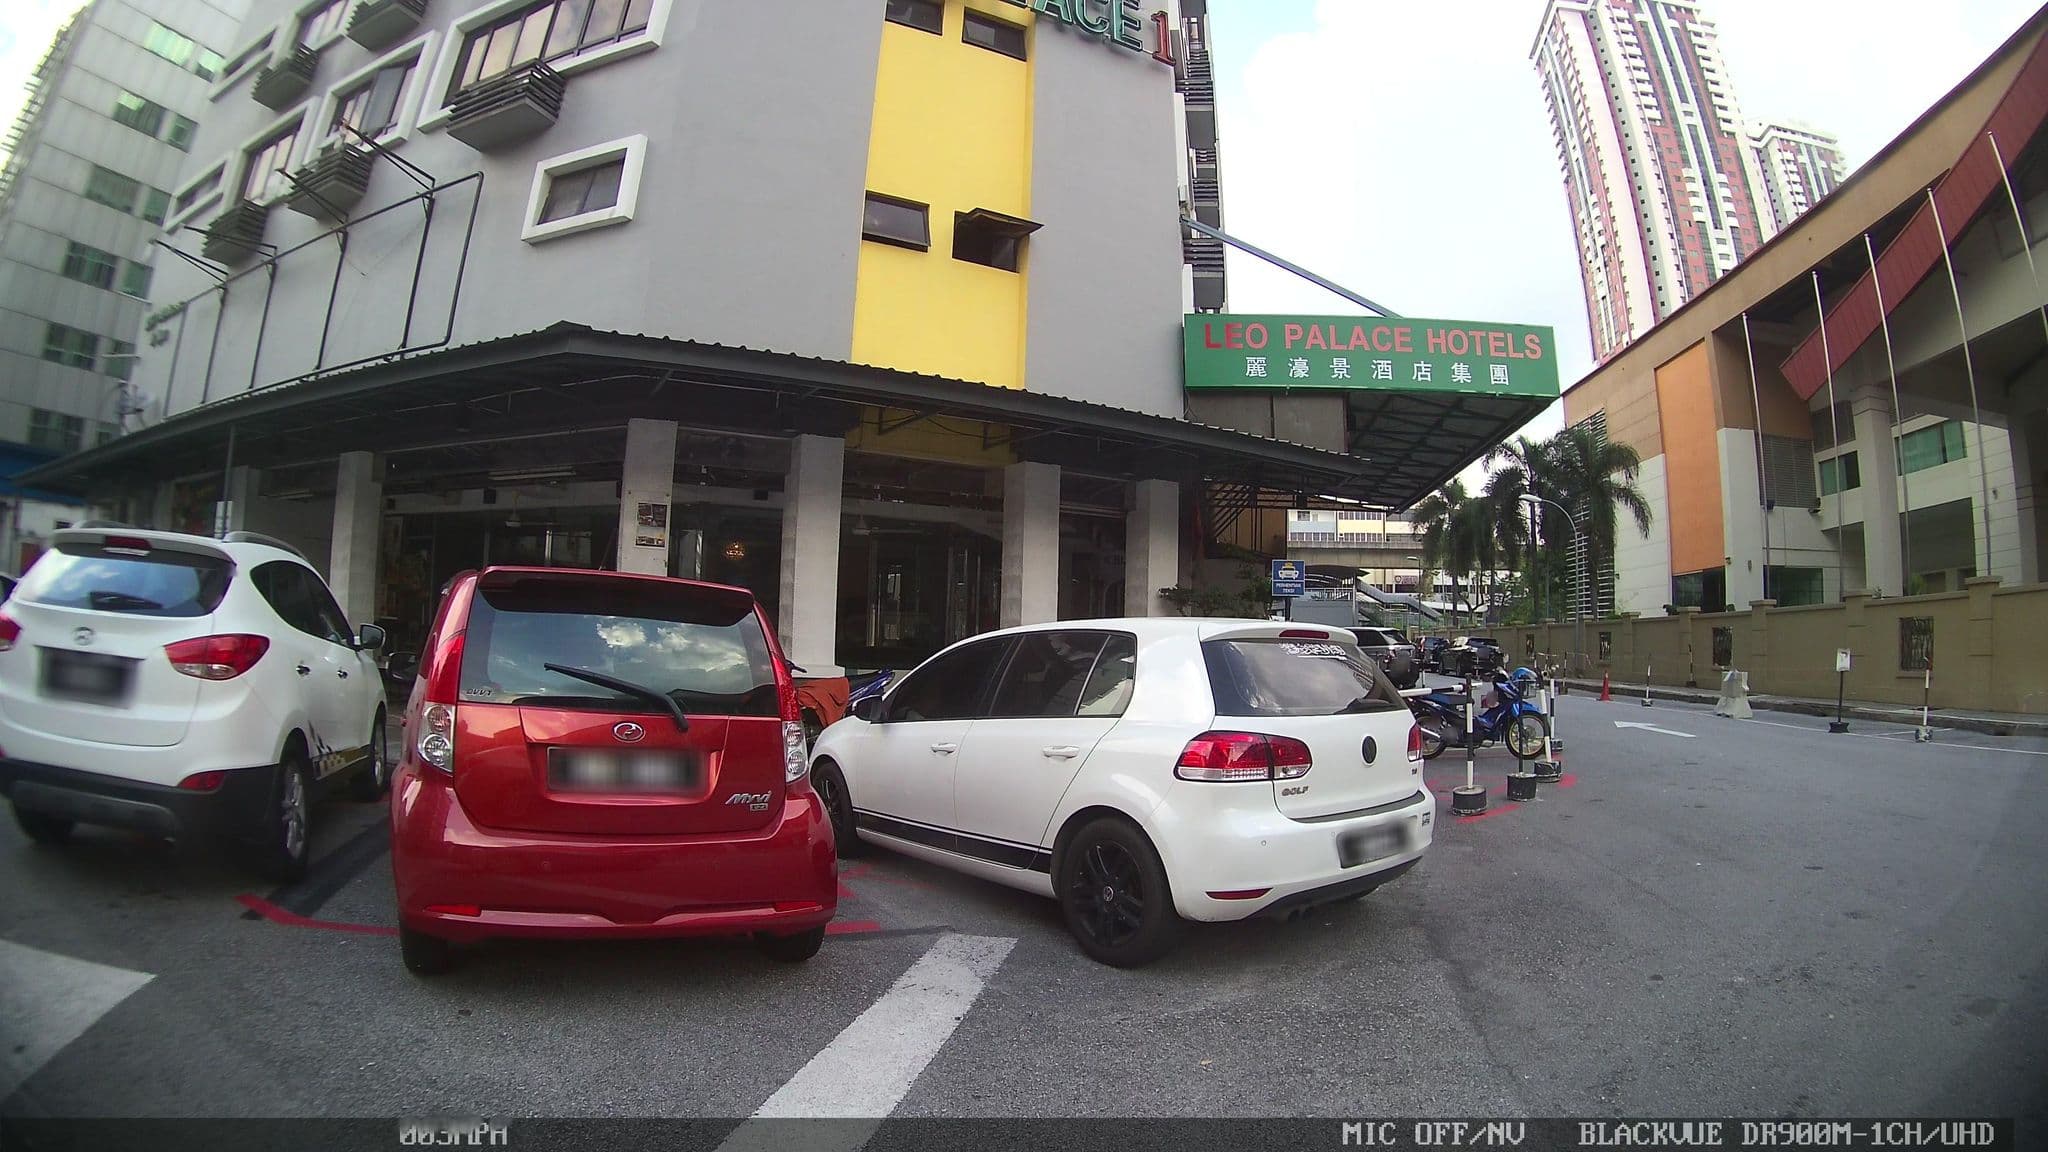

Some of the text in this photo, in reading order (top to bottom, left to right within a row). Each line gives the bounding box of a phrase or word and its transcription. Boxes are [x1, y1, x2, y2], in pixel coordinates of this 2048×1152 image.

[1151, 11, 1176, 66] 1
[1204, 323, 1542, 360] LEO PALACE HOTELS
